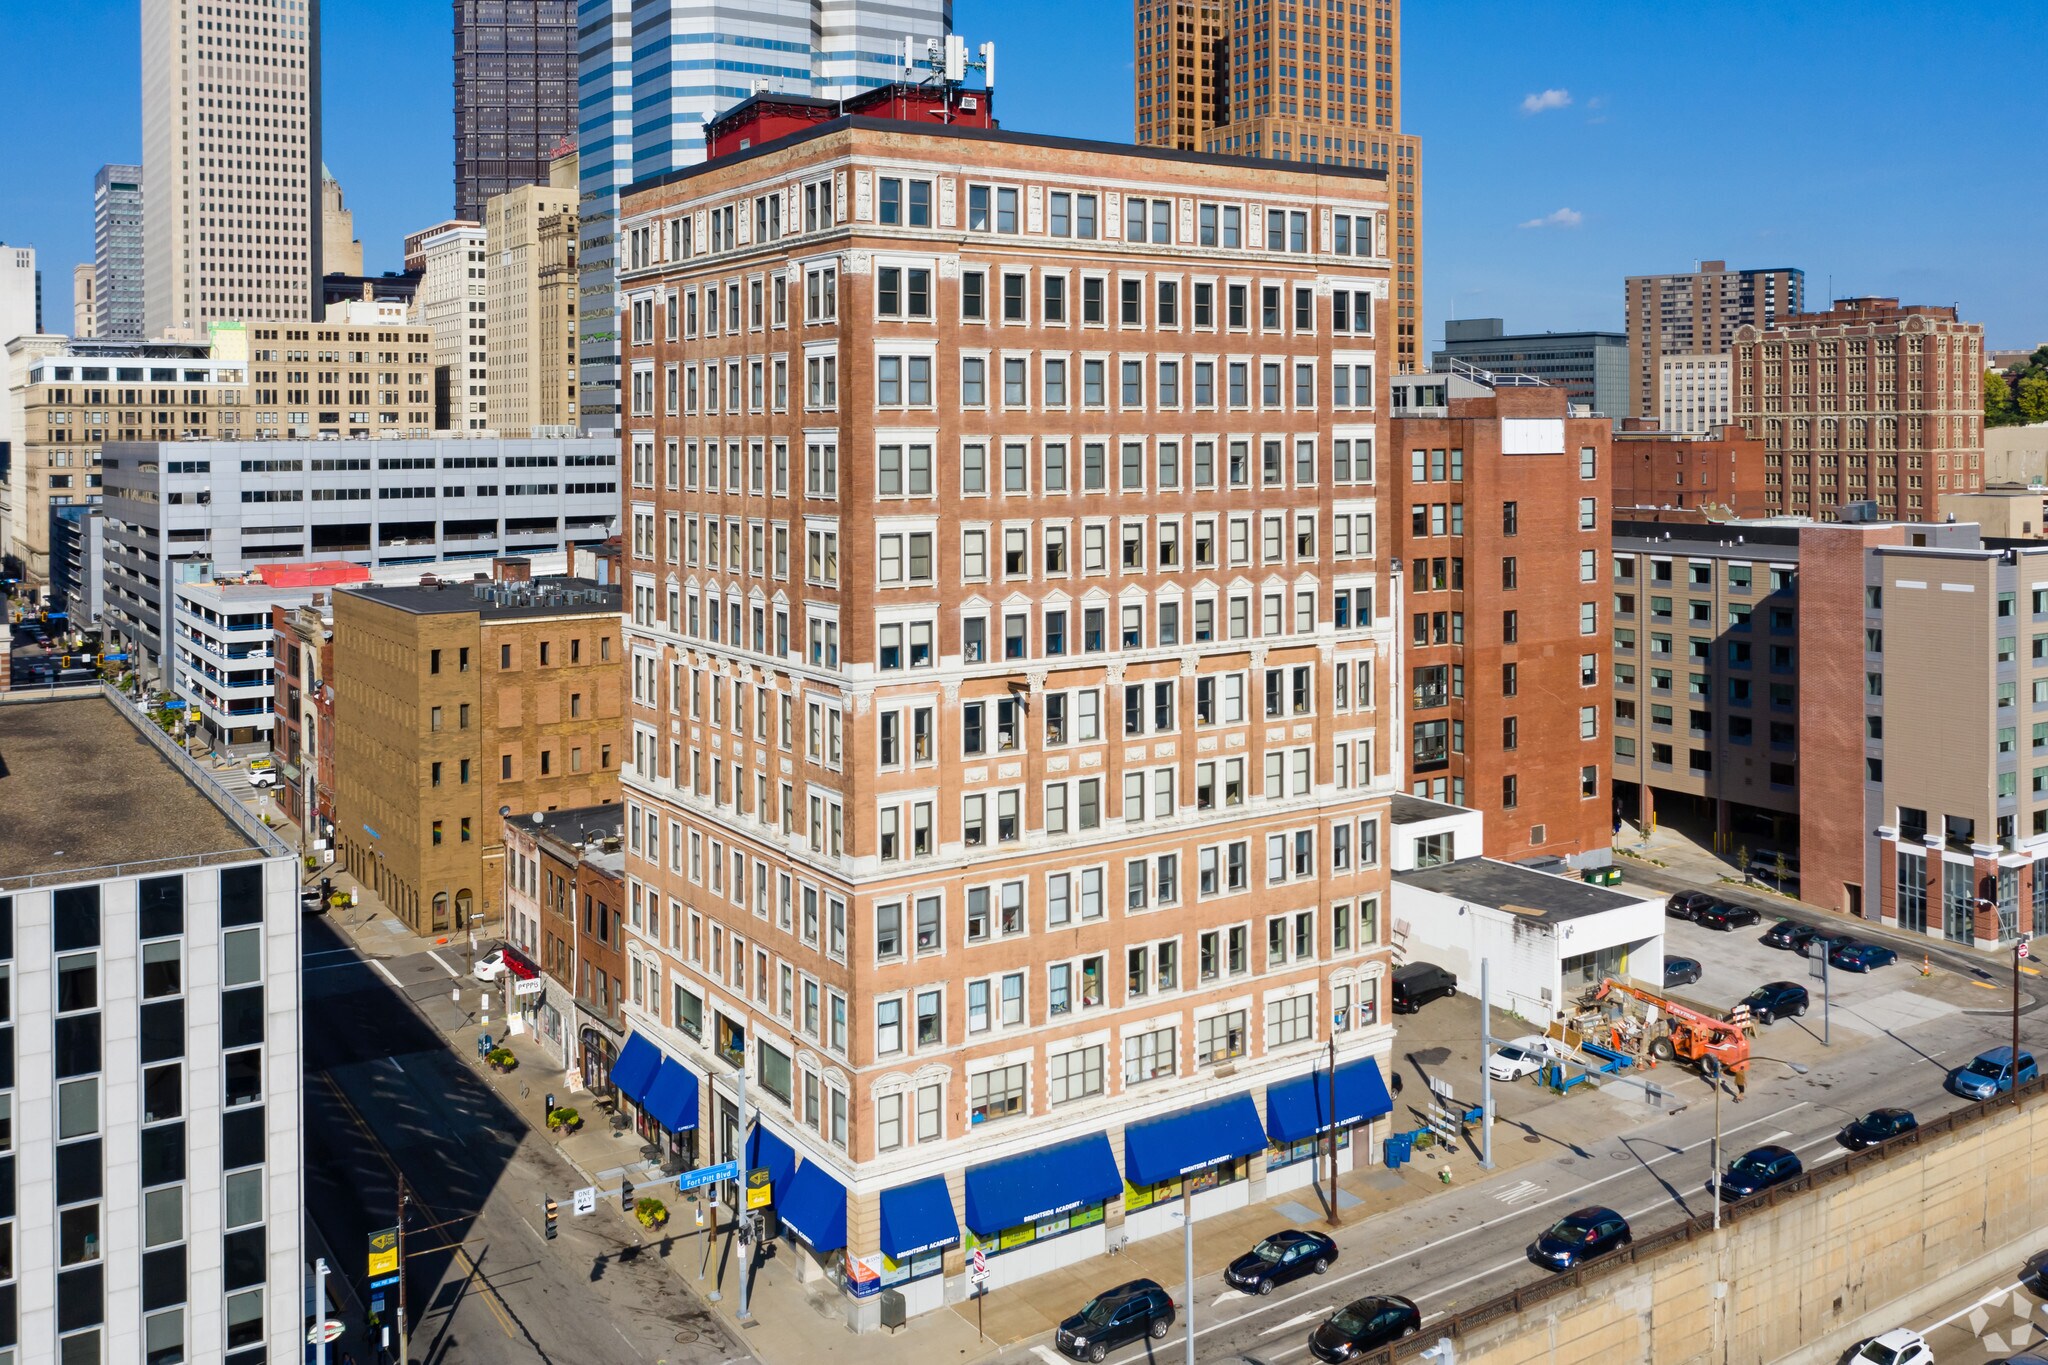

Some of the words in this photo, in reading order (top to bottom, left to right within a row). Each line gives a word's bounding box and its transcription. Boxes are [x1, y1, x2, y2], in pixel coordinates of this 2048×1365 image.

[1180, 1161, 1207, 1174] BRIGHTSIDE
[1208, 1154, 1230, 1166] ACADEMY
[687, 1178, 701, 1187] Fort
[702, 1175, 714, 1183] Pitt
[716, 1170, 731, 1180] Blvd
[578, 1190, 591, 1198] ONE
[578, 1196, 592, 1204] WAY
[1024, 1209, 1054, 1222] BRIGHTSIDE
[1055, 1200, 1080, 1214] ACADEMY
[897, 1244, 928, 1259] BRIGHTSIDE
[929, 1236, 955, 1249] ACADEMY
